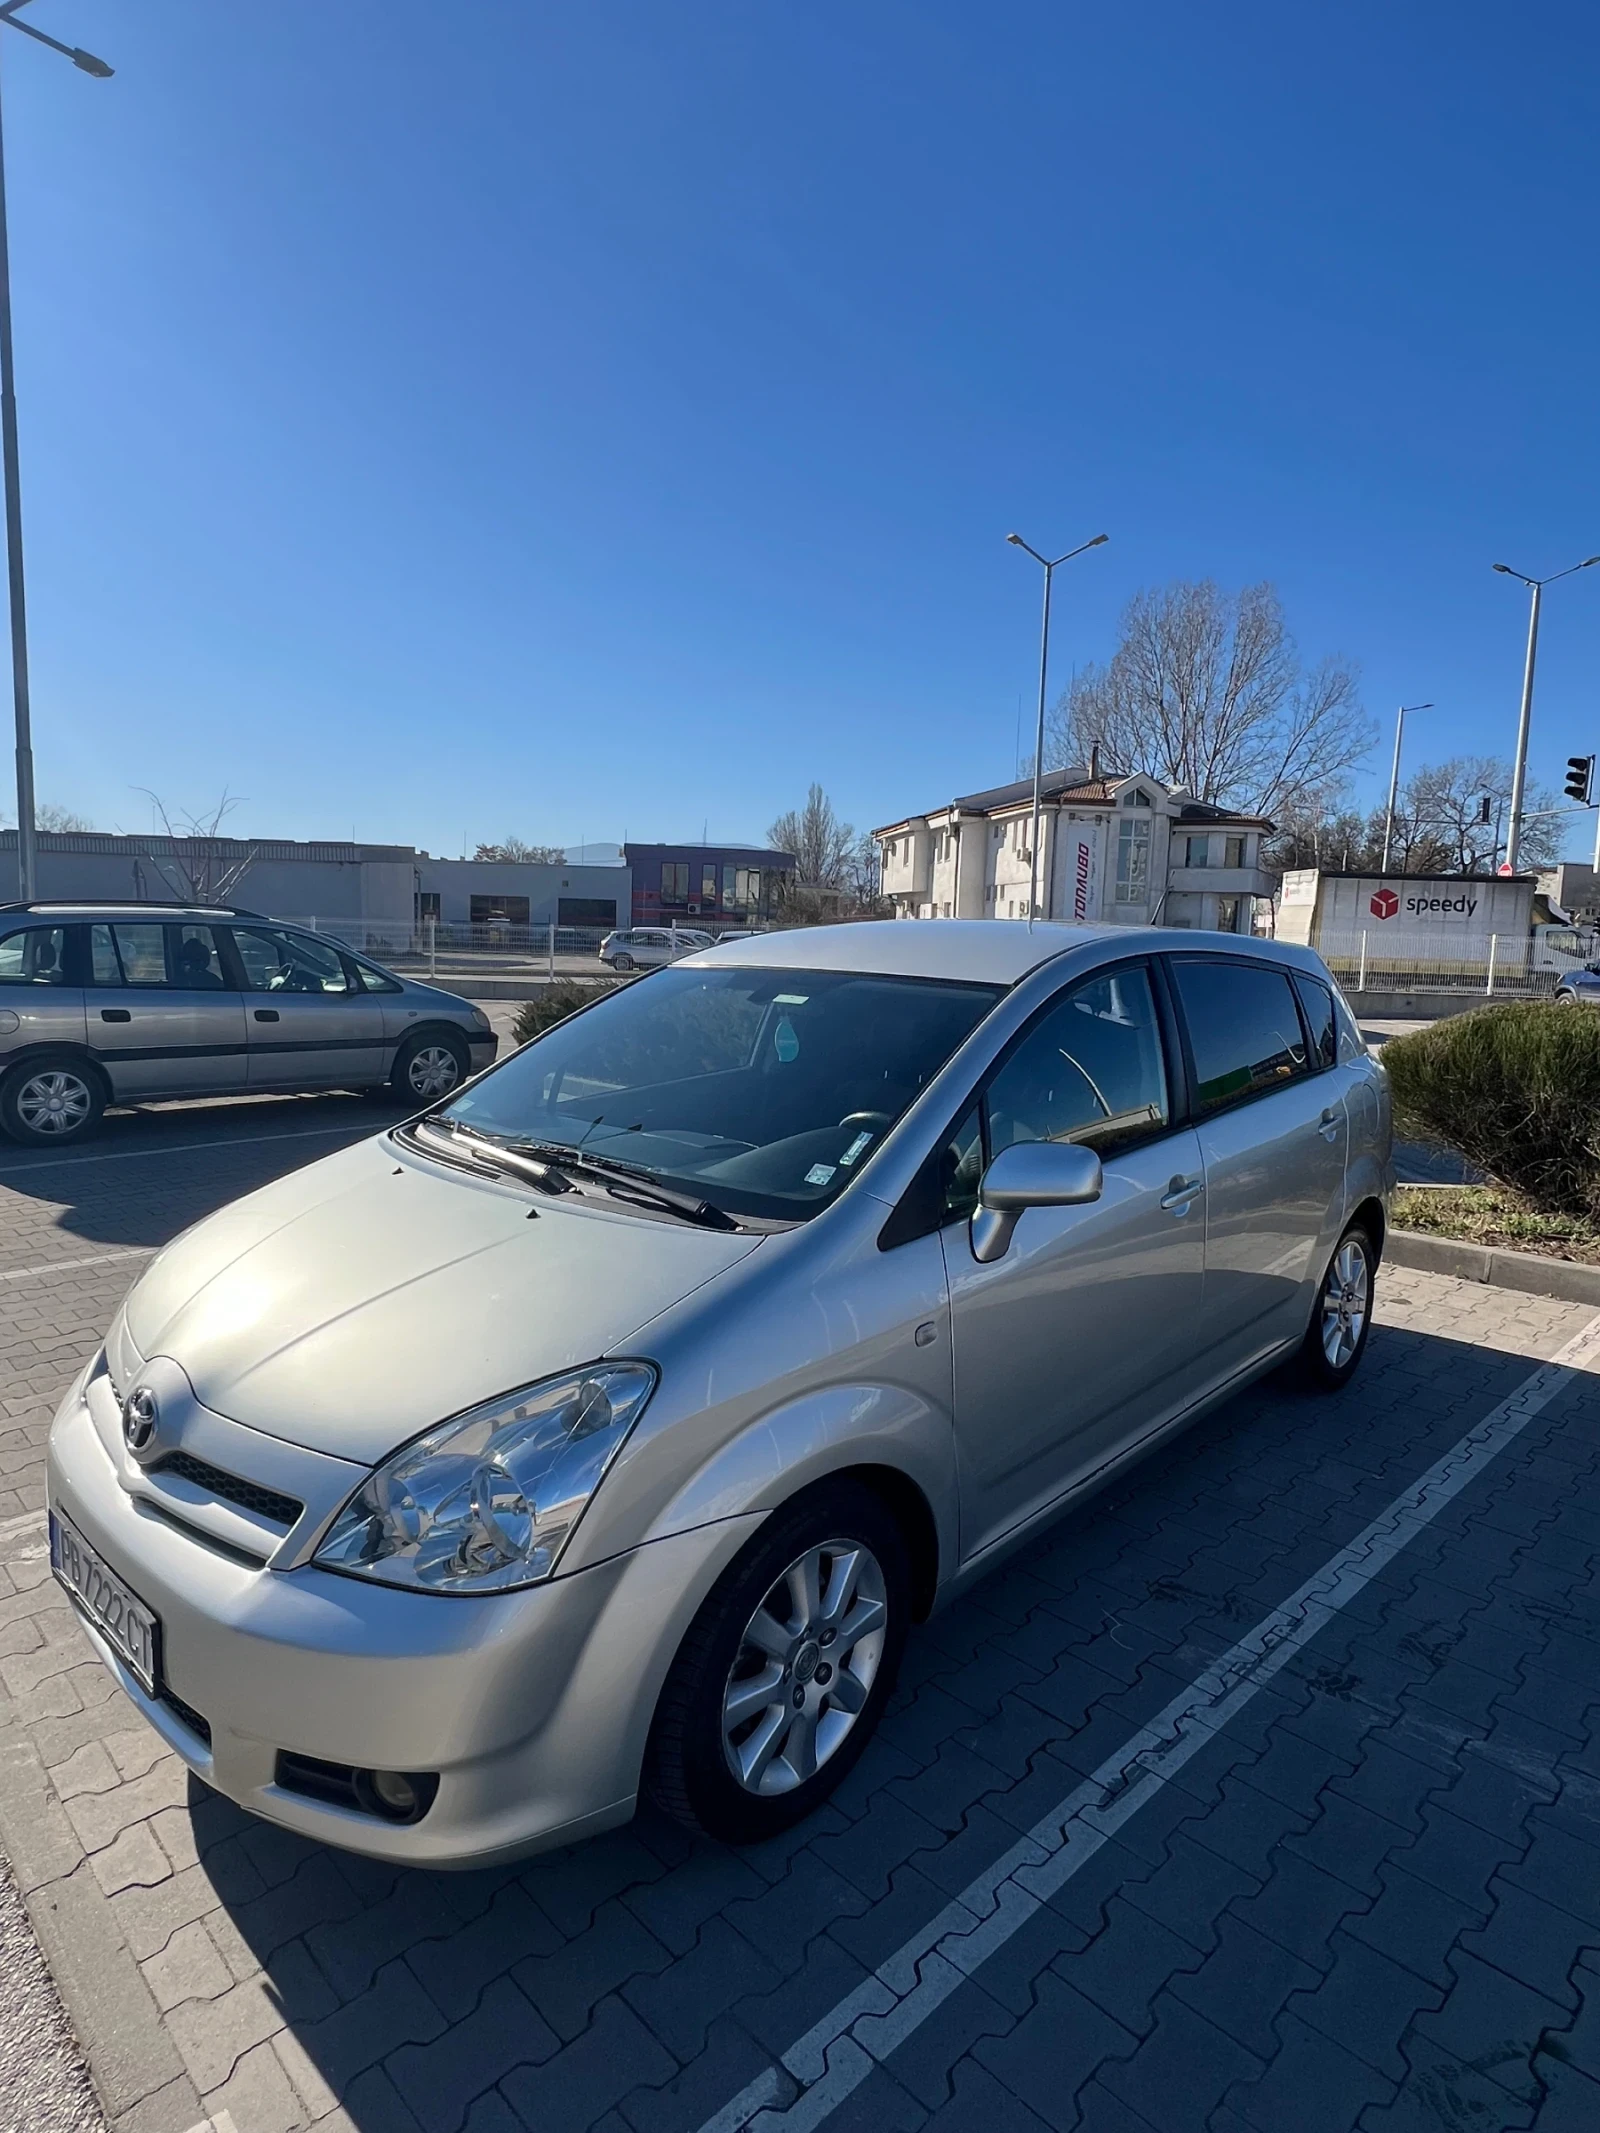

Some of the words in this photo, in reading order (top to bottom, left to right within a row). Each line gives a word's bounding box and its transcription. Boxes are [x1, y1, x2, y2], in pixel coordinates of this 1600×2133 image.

[1406, 894, 1478, 917] speedy
[61, 1528, 81, 1586] PB
[83, 1554, 125, 1642] 7222
[127, 1607, 150, 1669] CT
